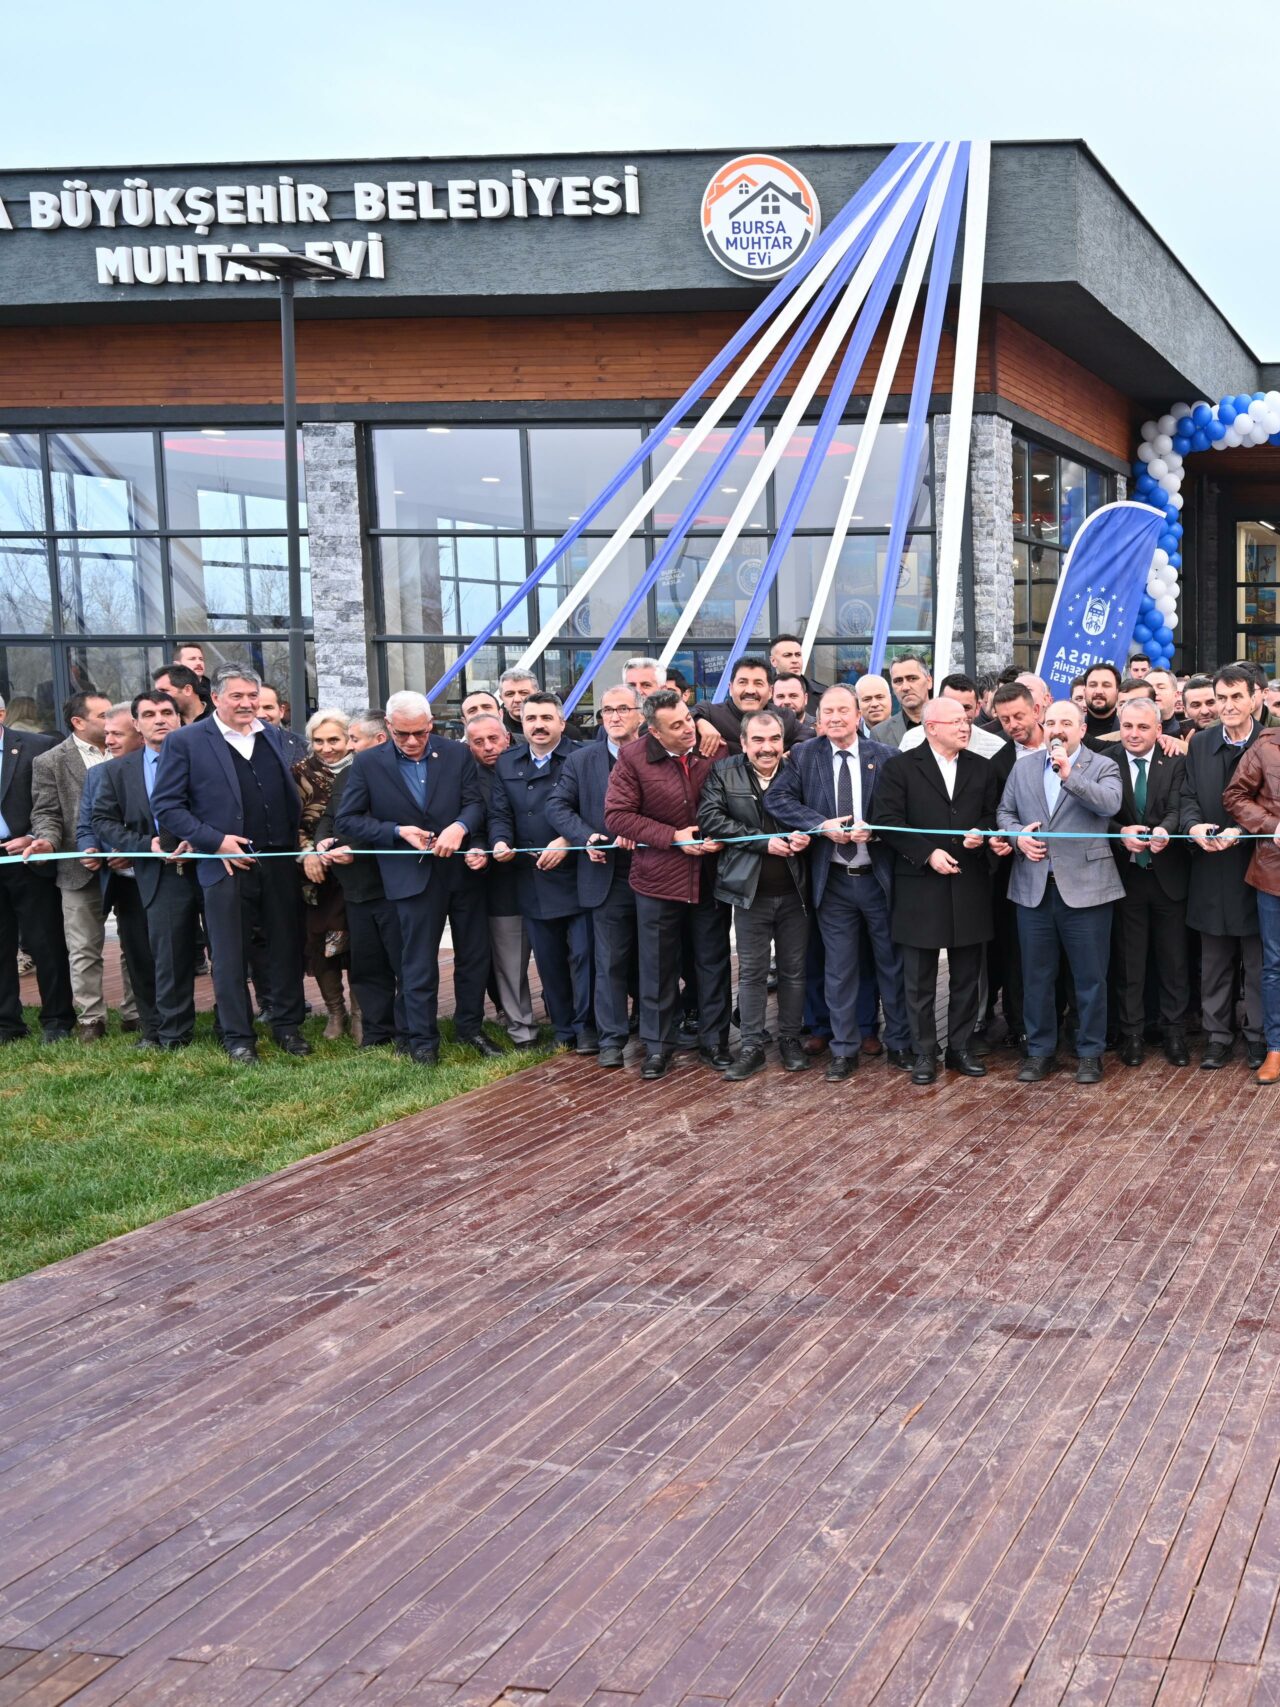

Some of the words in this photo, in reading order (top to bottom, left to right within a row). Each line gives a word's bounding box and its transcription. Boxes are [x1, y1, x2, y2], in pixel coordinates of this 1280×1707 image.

[29, 176, 331, 236] BÜYÜKŞEHİR
[354, 165, 640, 222] BELEDİYESİ
[731, 220, 787, 235] BURSA
[725, 236, 793, 251] MUHTAR
